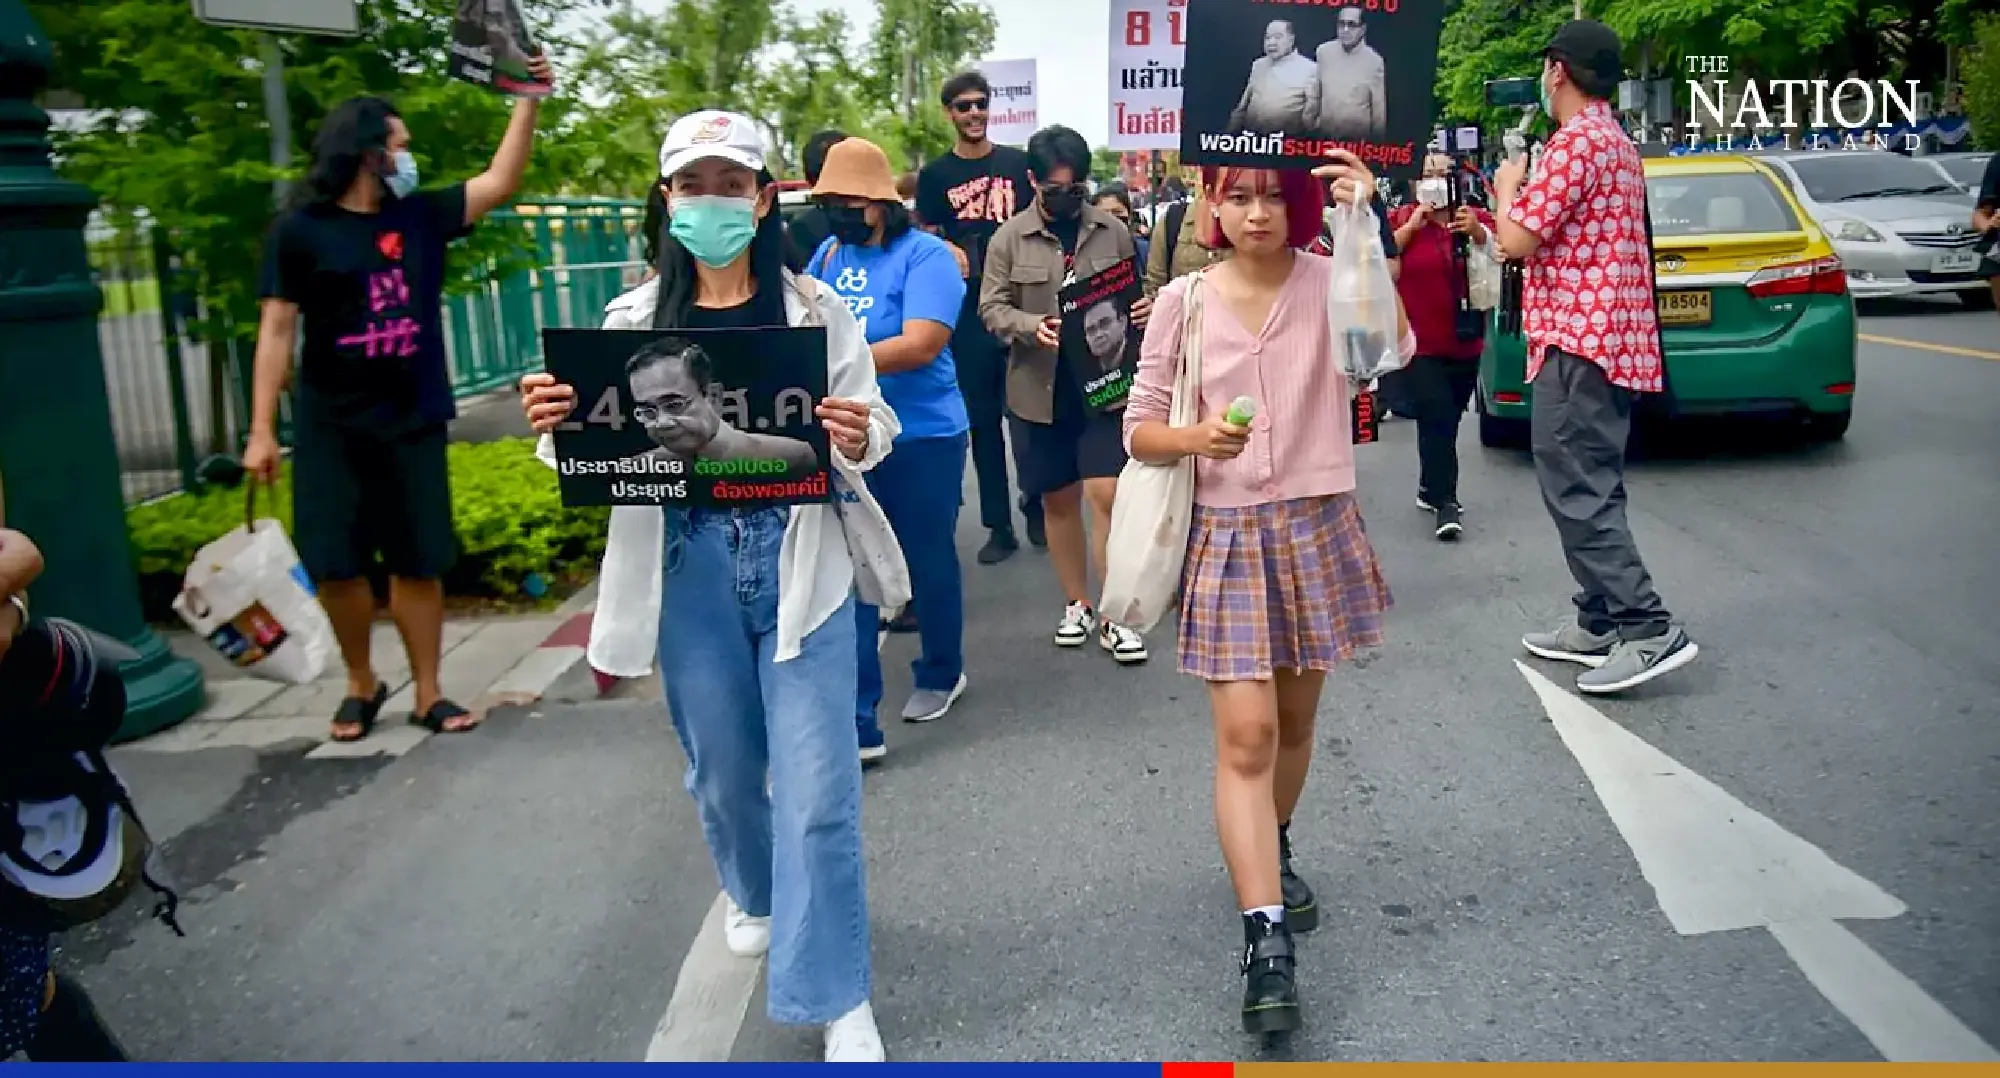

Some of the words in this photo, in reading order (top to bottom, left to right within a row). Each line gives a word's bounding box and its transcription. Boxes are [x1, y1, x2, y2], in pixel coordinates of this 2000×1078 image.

[1126, 11, 1151, 46] 8
[560, 454, 684, 476] ประชาธิปไตย
[611, 479, 687, 503] ประยุทธ์
